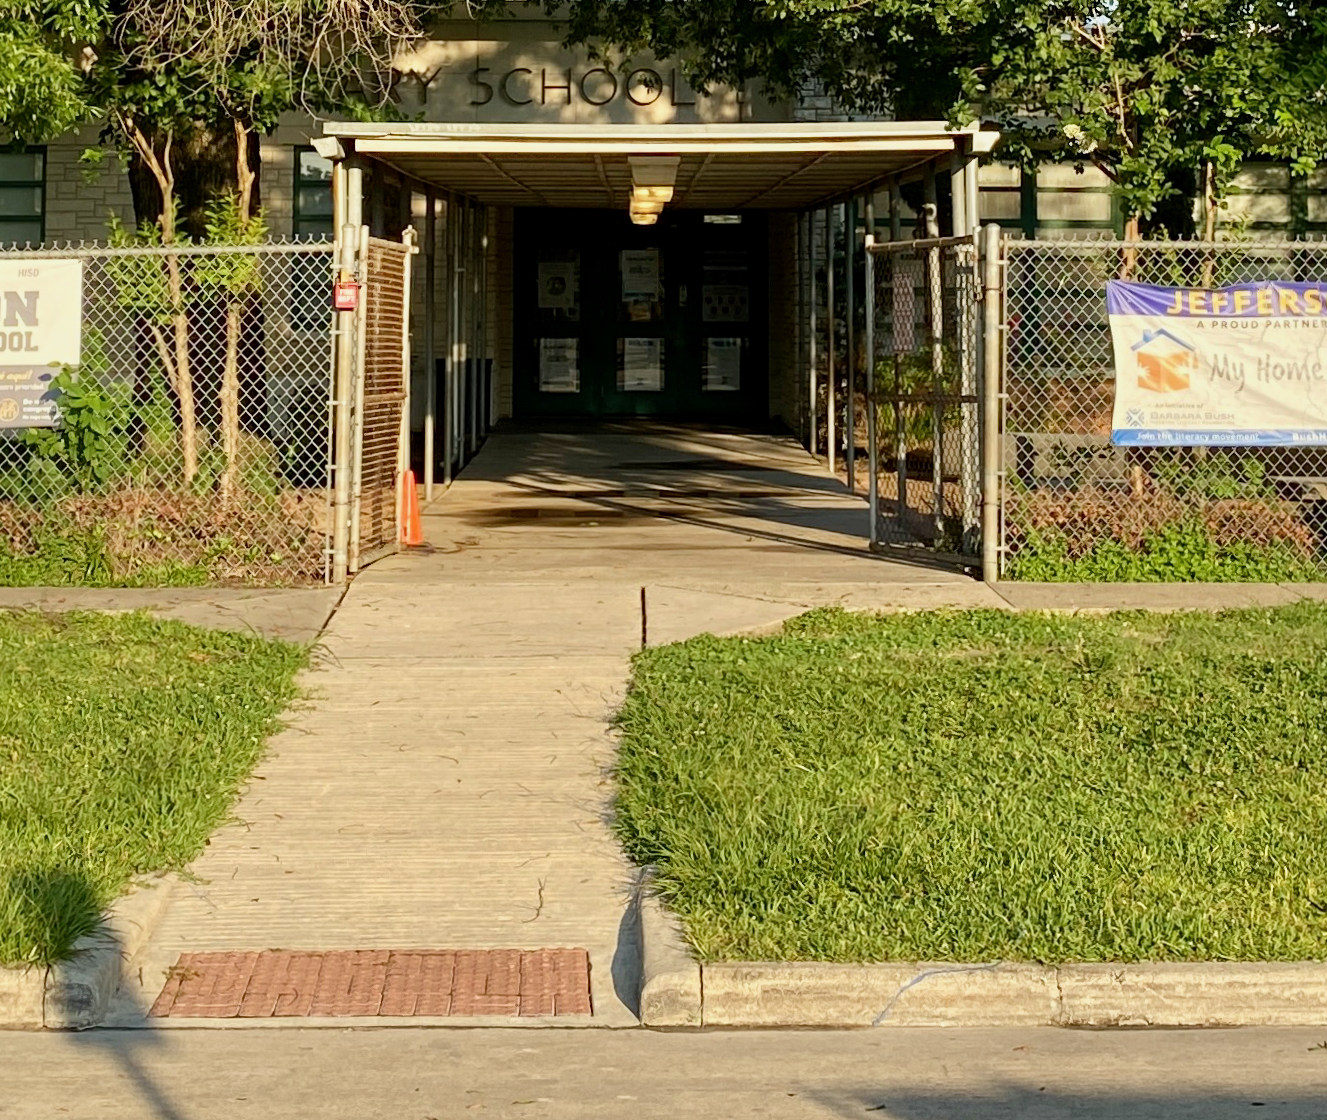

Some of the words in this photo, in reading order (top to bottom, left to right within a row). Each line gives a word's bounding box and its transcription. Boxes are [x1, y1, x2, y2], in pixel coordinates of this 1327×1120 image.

[470, 67, 696, 106] SCHOOL
[18, 268, 40, 278] HISD
[1196, 320, 1205, 329] A
[1211, 320, 1259, 329] PROUD
[1265, 319, 1327, 329] PARTNER
[1210, 353, 1246, 394] My
[1257, 353, 1324, 383] Home
[1150, 411, 1202, 420] BARBARA
[1205, 412, 1235, 420] BUSH
